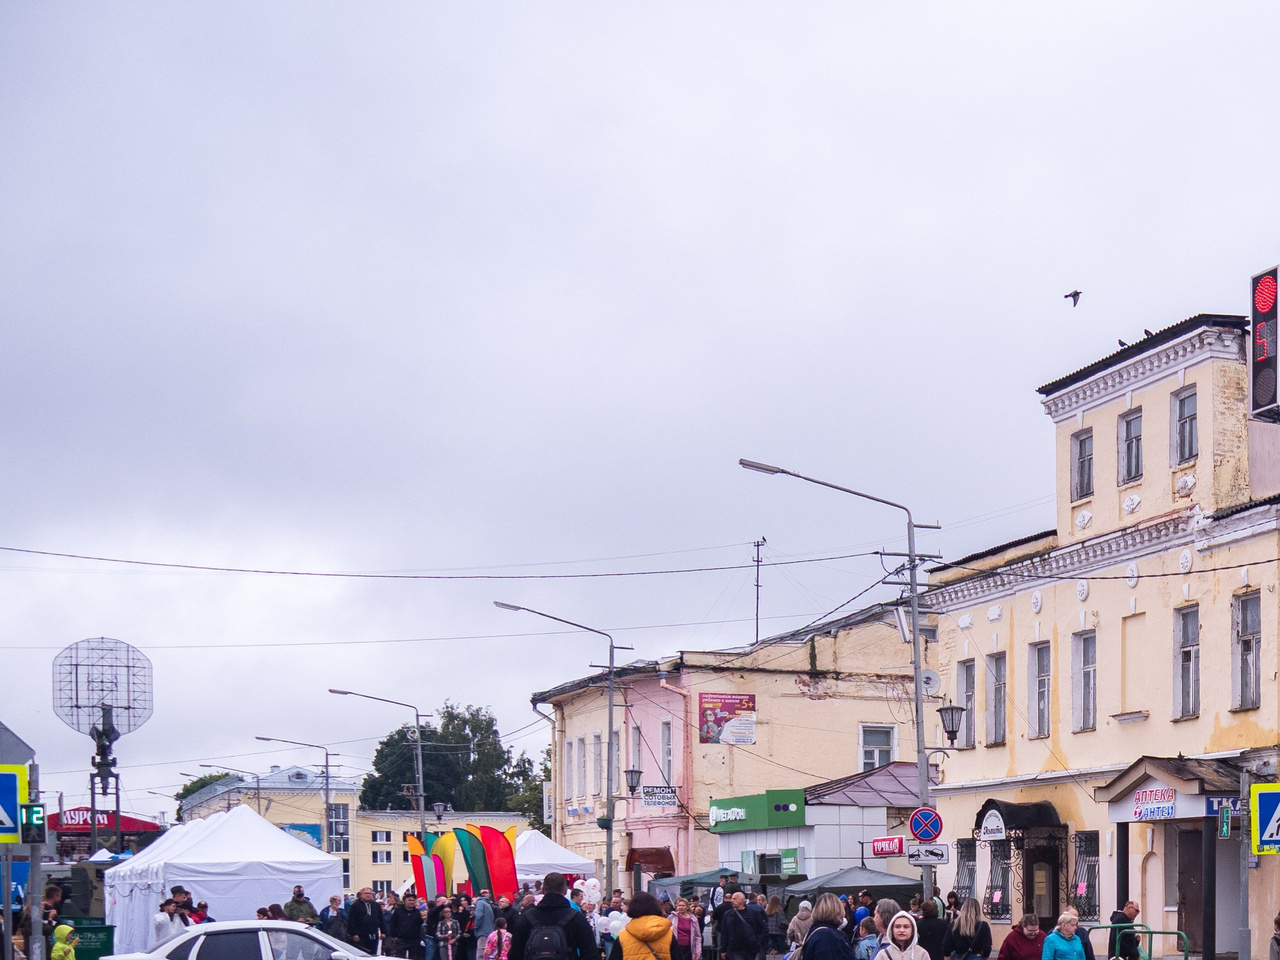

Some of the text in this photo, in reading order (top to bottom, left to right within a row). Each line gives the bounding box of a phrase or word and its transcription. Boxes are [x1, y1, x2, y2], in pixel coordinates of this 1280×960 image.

[741, 699, 754, 709] 5+
[643, 786, 677, 794] РЕМОНТ
[1134, 787, 1174, 803] АПТЕКА
[20, 806, 44, 825] 12
[1143, 803, 1174, 818] АНТЕЙ
